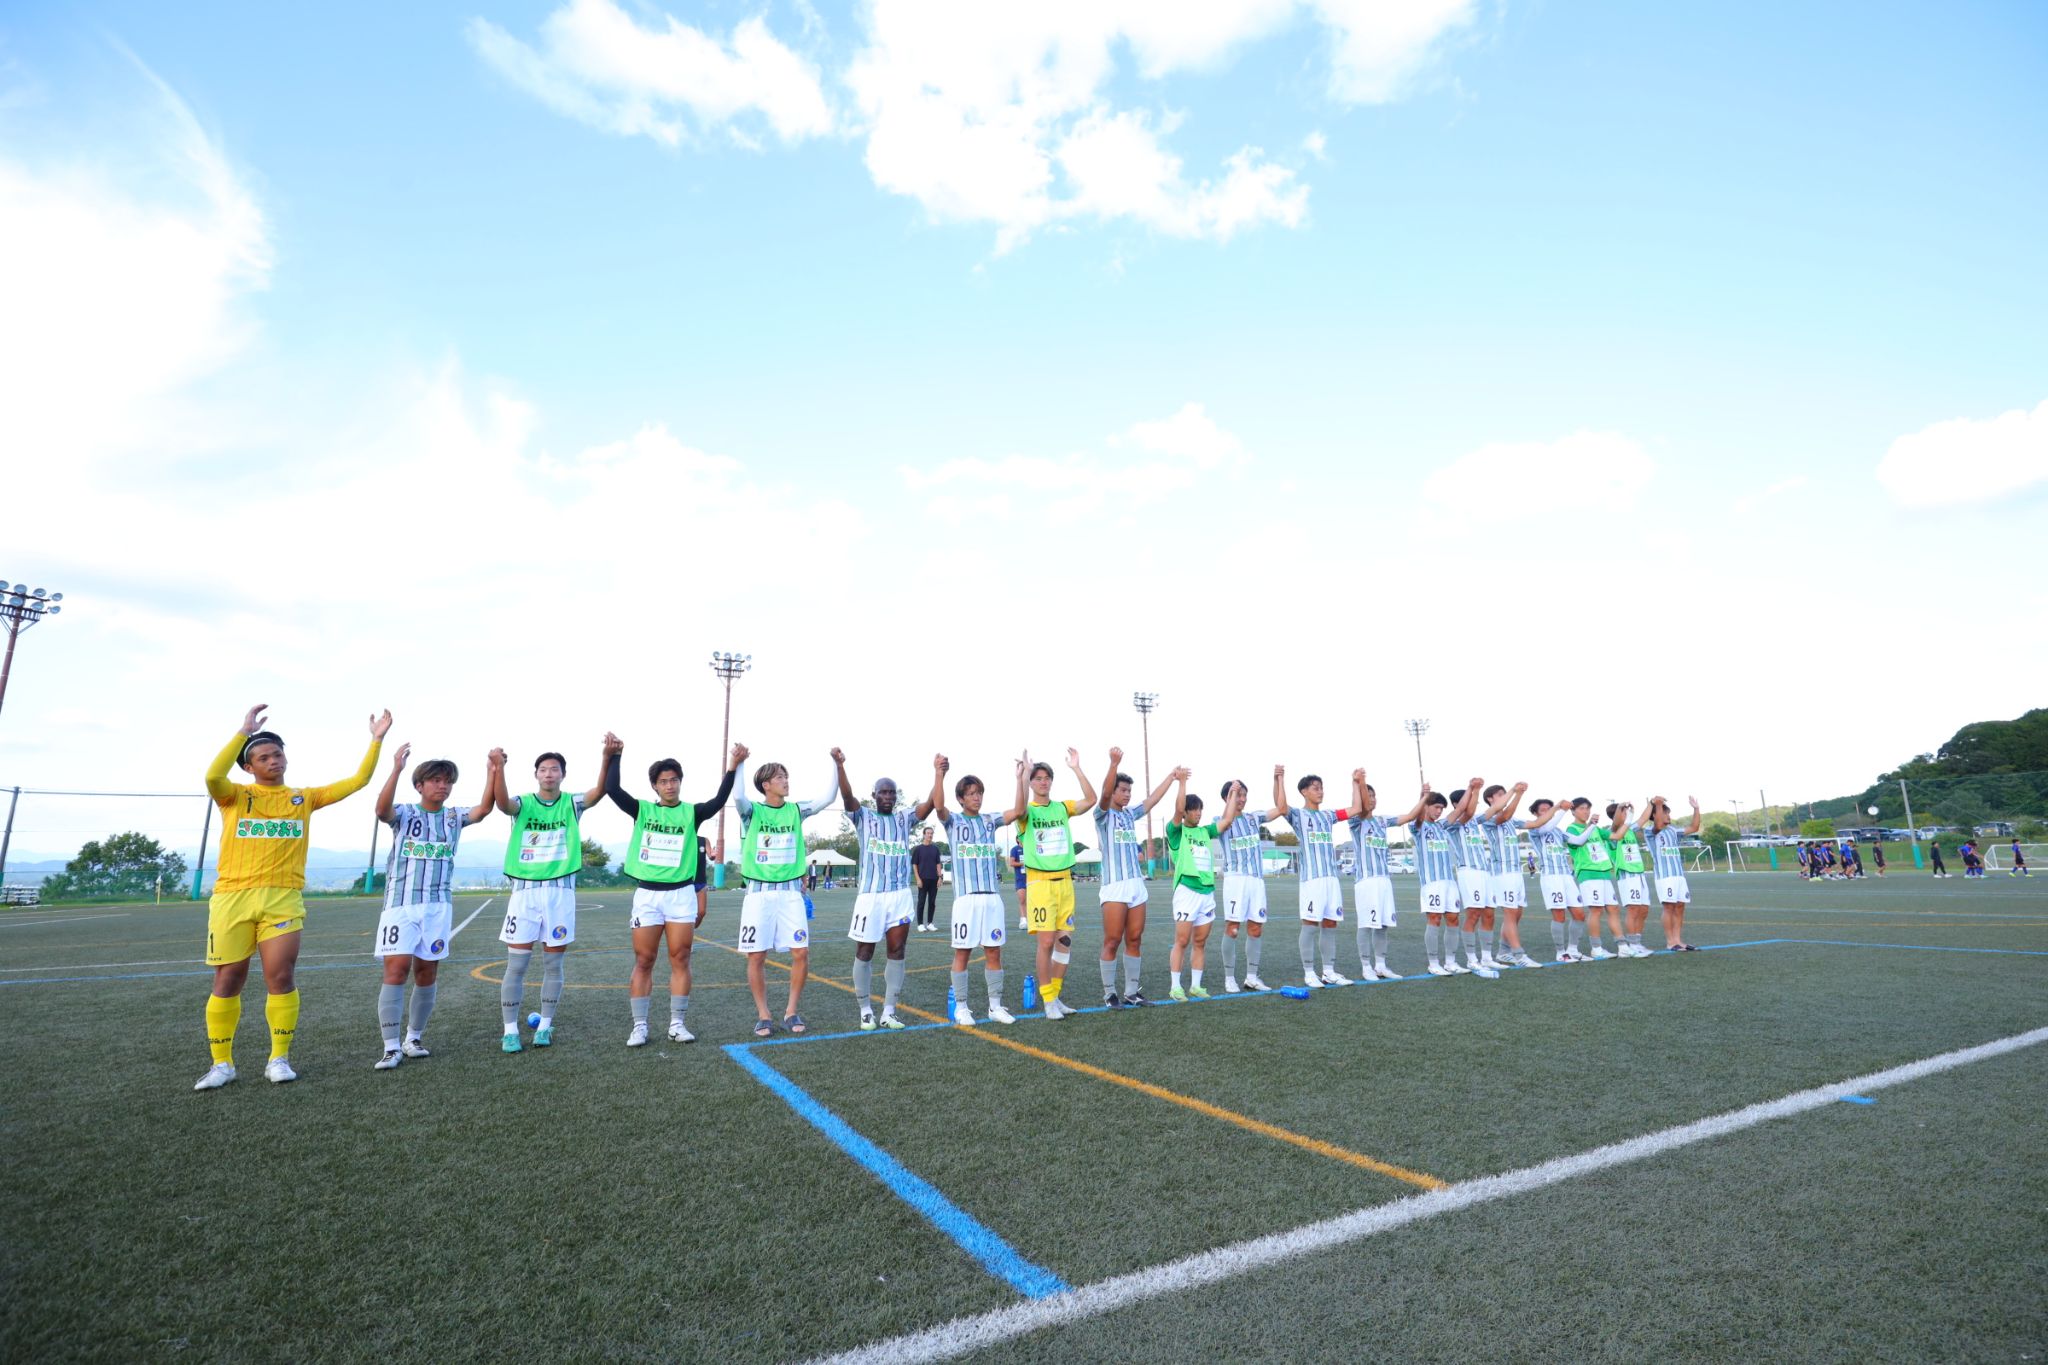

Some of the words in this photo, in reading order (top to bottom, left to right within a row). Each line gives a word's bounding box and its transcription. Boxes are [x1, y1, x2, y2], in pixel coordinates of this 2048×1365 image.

[406, 817, 422, 837] 18
[525, 820, 566, 831] ATHLETA
[956, 826, 969, 842] 10
[1474, 890, 1480, 902] 6
[1504, 891, 1514, 903] 15
[1552, 892, 1563, 903] 29
[1593, 890, 1599, 901] 5
[1630, 889, 1641, 900] 28
[1668, 887, 1673, 897] 8
[1429, 894, 1441, 906] 26
[1230, 900, 1236, 914] 7
[1308, 901, 1313, 913] 4
[1034, 907, 1046, 923] 20
[1176, 911, 1189, 922] 27
[1371, 910, 1377, 922] 2
[505, 915, 517, 934] 25
[854, 914, 867, 933] 11
[383, 925, 399, 945] 18
[742, 926, 756, 943] 22
[954, 923, 967, 940] 10
[210, 933, 214, 953] 1
